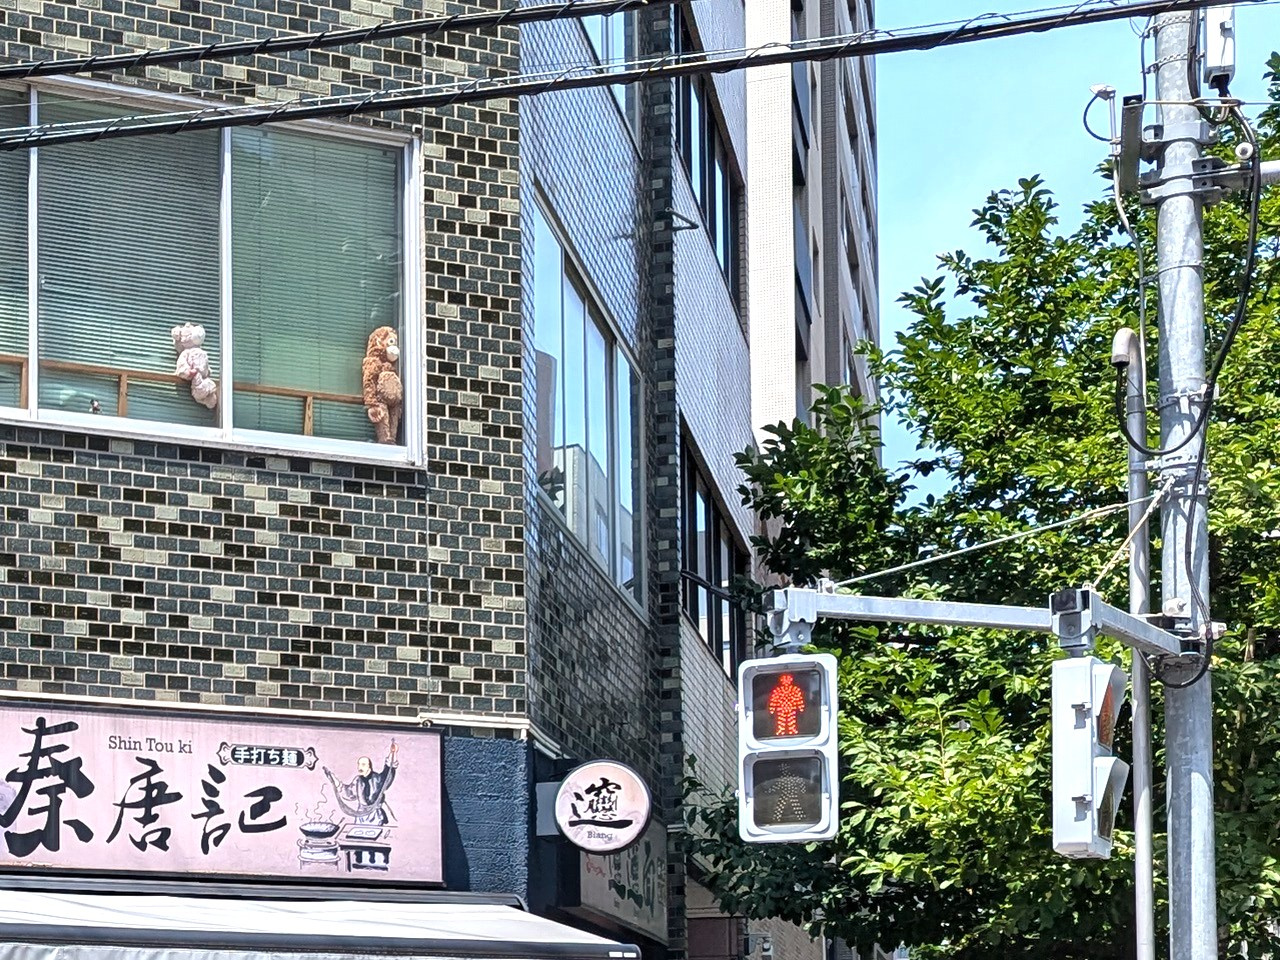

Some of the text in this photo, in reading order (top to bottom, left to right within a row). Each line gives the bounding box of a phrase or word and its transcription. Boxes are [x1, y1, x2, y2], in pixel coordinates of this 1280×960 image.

[108, 735, 193, 754] Shin Tou ki
[234, 745, 299, 767] 手打ち麺
[587, 831, 614, 841] Biang
